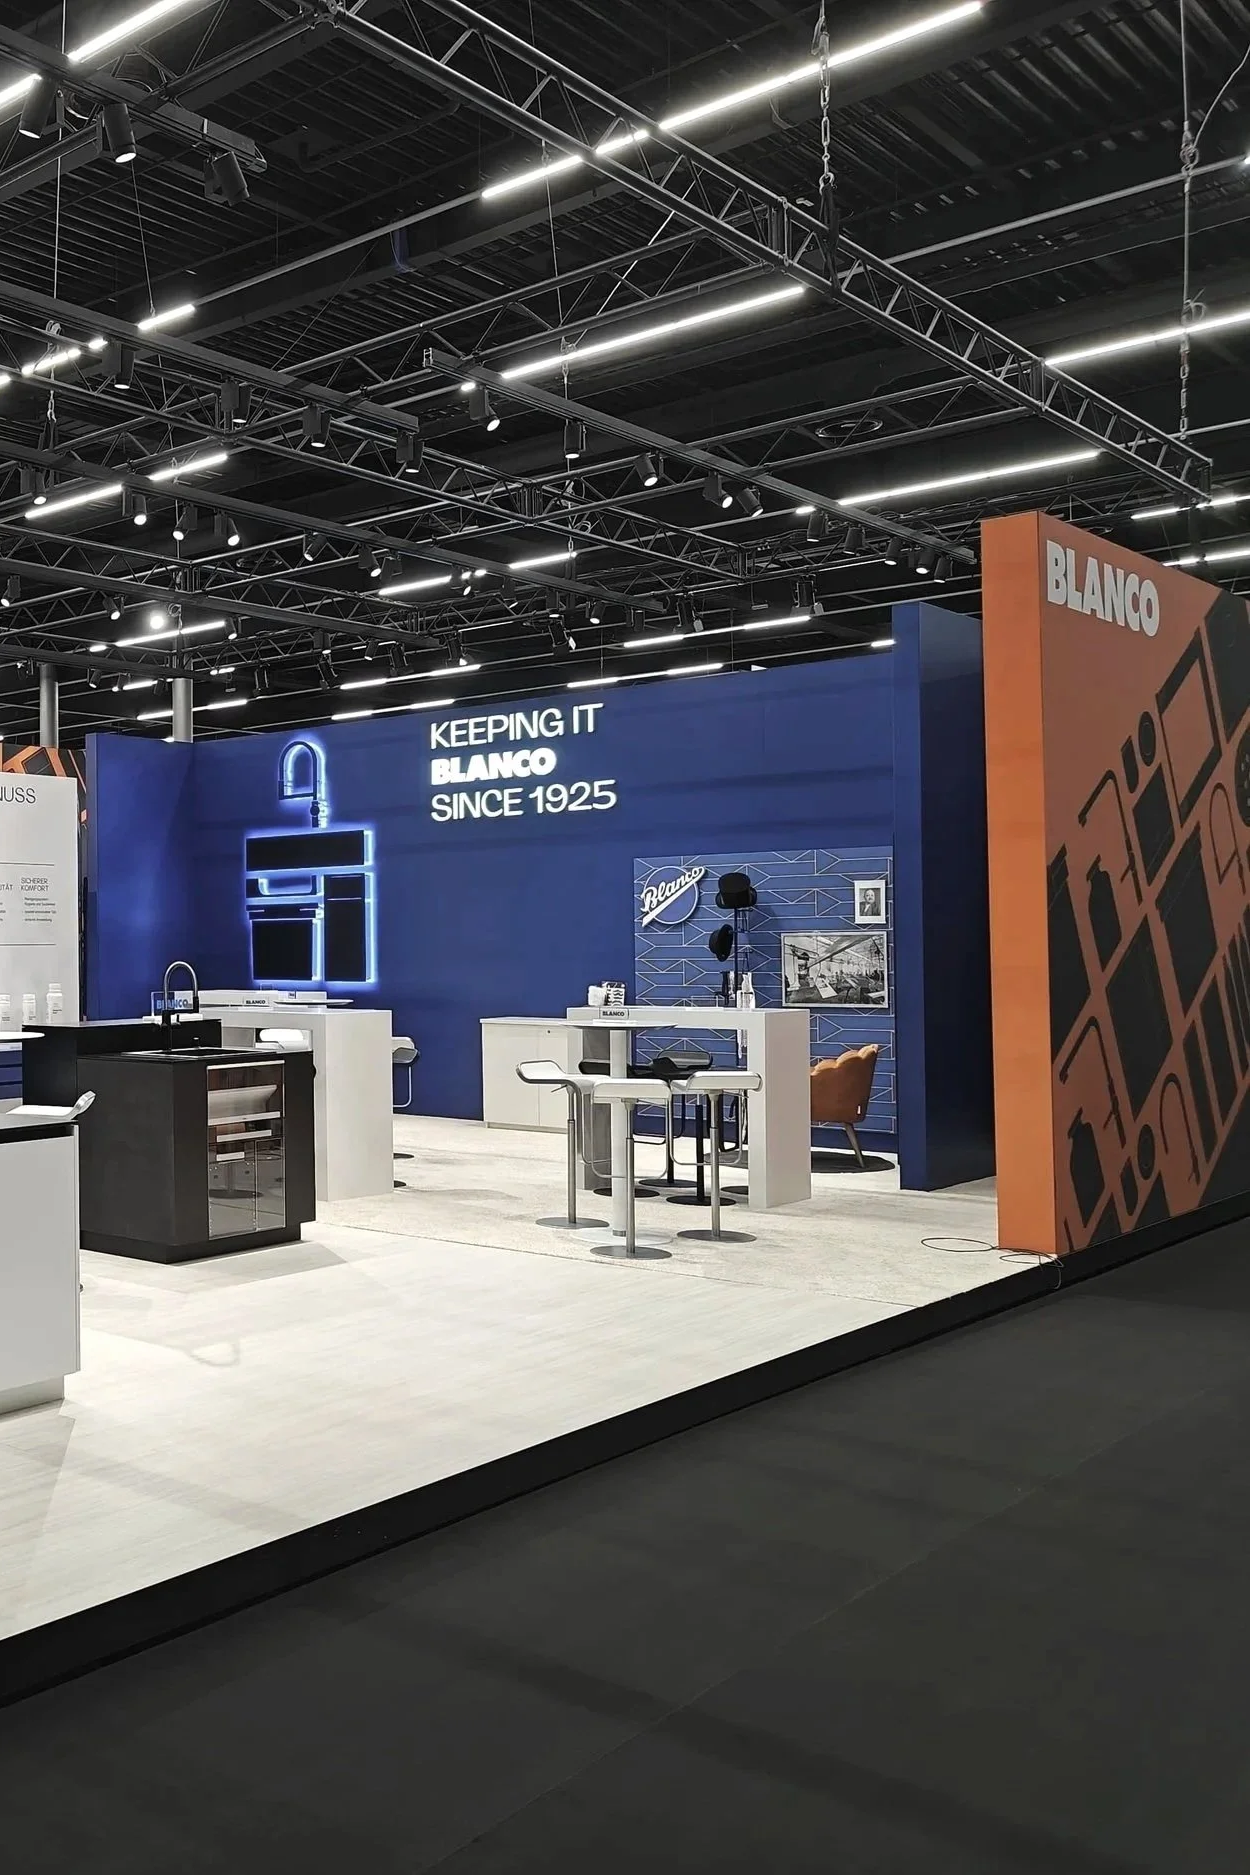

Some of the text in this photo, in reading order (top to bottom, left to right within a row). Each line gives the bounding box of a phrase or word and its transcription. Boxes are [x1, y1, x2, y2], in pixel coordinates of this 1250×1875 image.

[1046, 539, 1160, 637] BLANCO
[430, 702, 604, 750] KEEPING IT
[430, 747, 557, 786] BLANCO
[430, 779, 617, 822] SINCE 1925
[20, 877, 49, 885] SICHERER
[640, 866, 705, 913] Blanco
